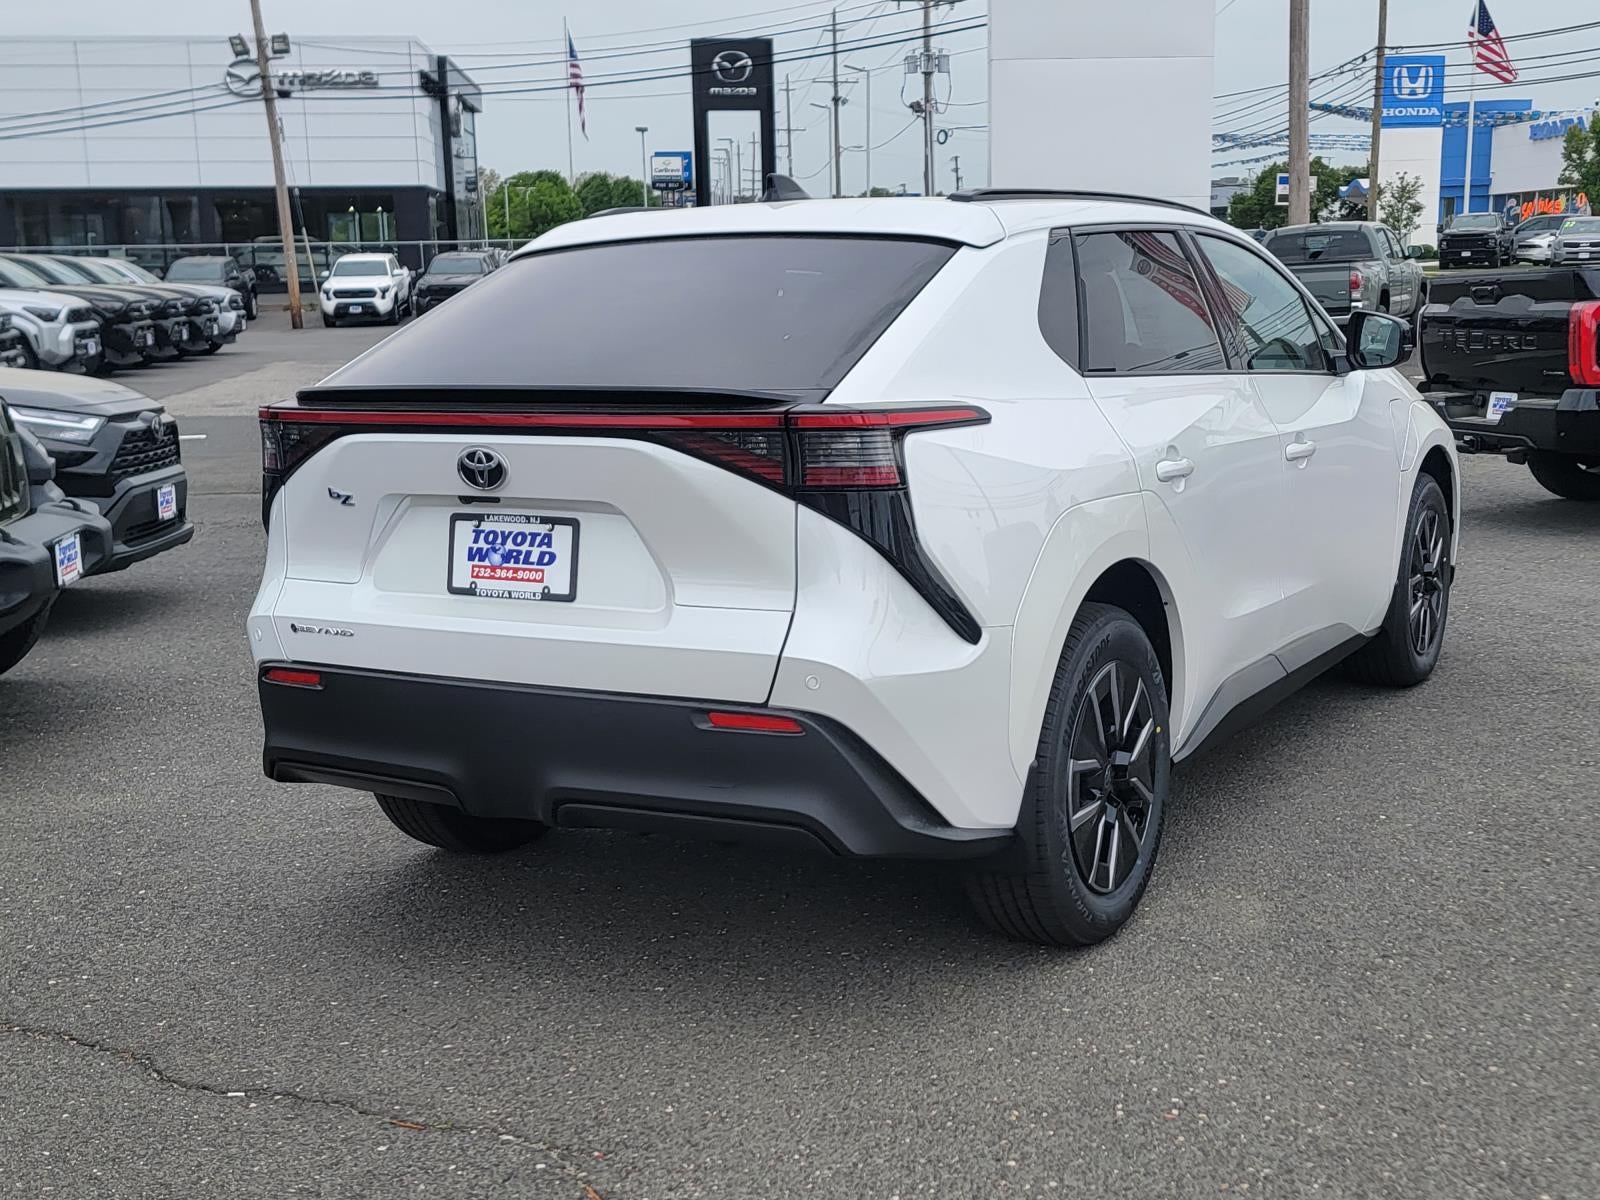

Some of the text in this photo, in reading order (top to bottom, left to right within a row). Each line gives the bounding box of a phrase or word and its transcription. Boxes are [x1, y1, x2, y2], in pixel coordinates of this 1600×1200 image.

[709, 87, 757, 95] mazda
[1382, 107, 1441, 117] HONDA
[472, 529, 553, 549] TOYOTA
[472, 567, 543, 581] 732-364-9000
[476, 588, 542, 600] TOYOTA WORLD
